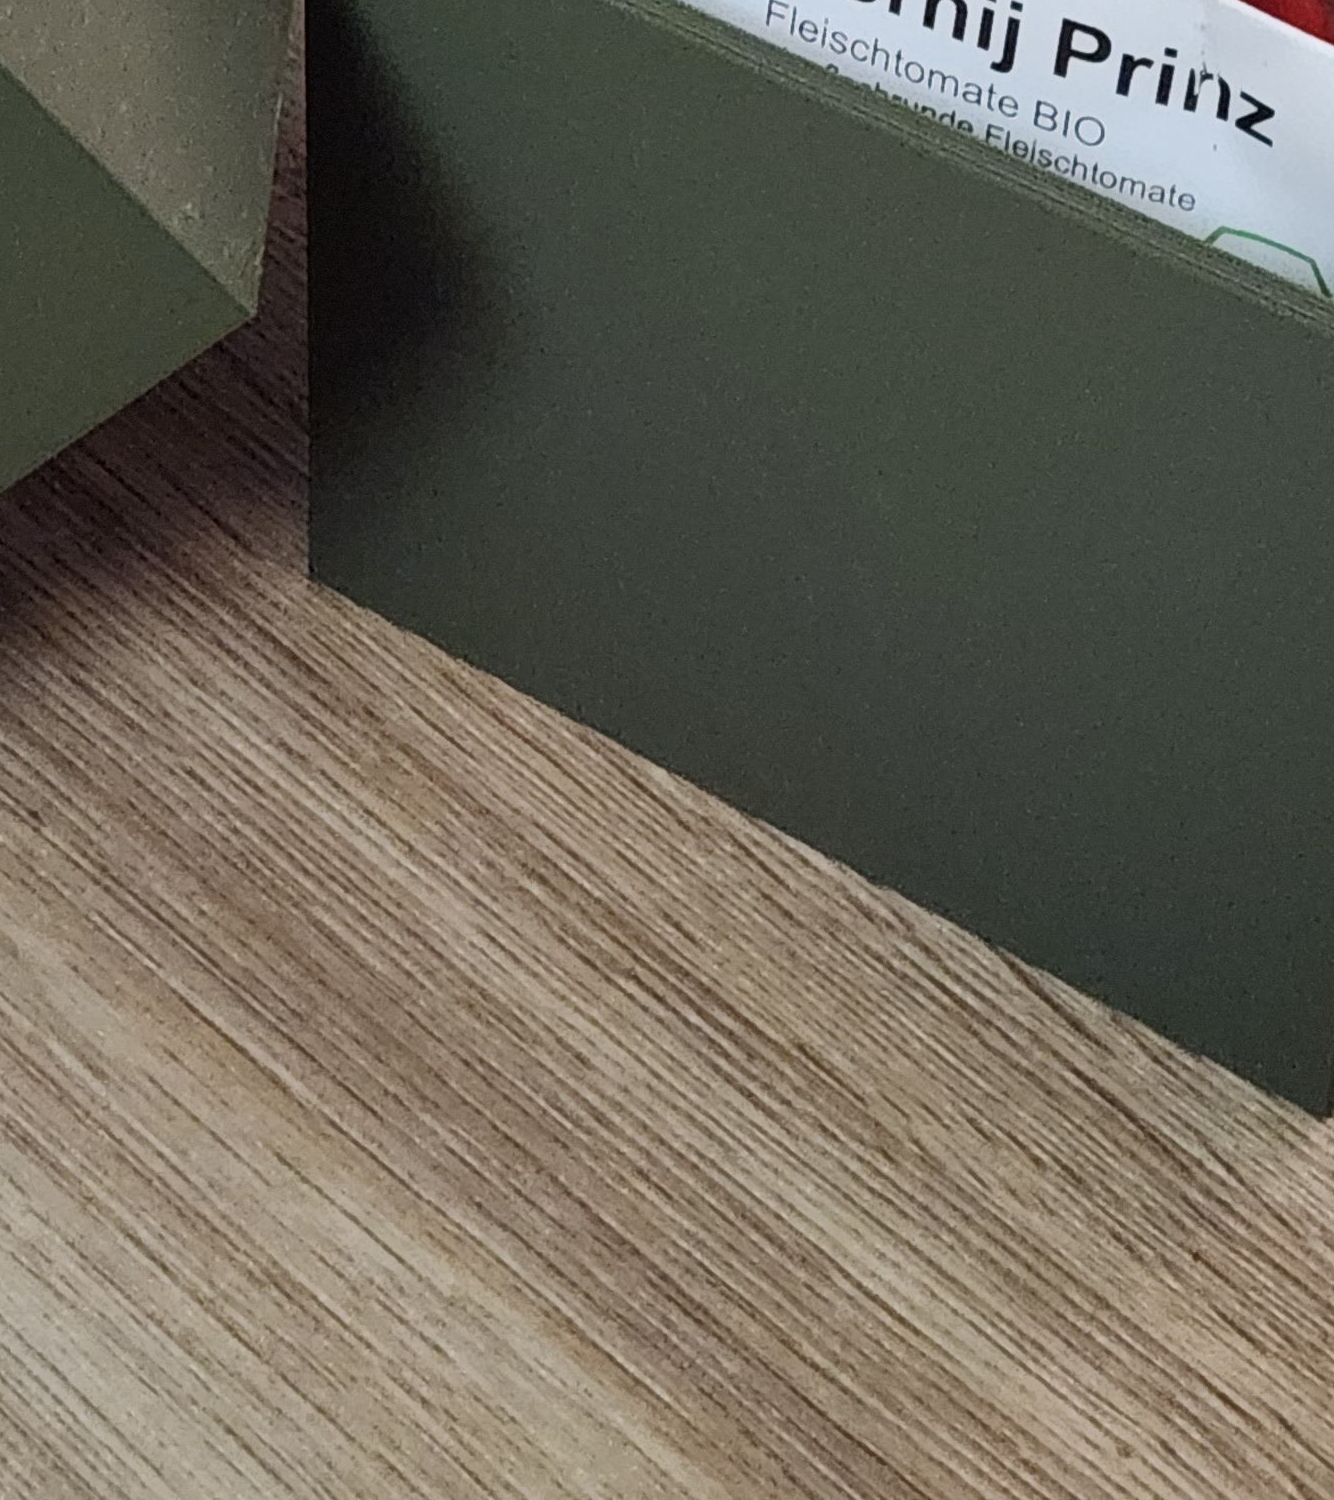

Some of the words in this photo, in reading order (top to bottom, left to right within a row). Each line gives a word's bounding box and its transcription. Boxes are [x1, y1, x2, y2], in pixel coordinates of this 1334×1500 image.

[766, 0, 1019, 119] Fleischtomate
[1033, 99, 1106, 147] BIO
[1054, 17, 1275, 147] Prinz
